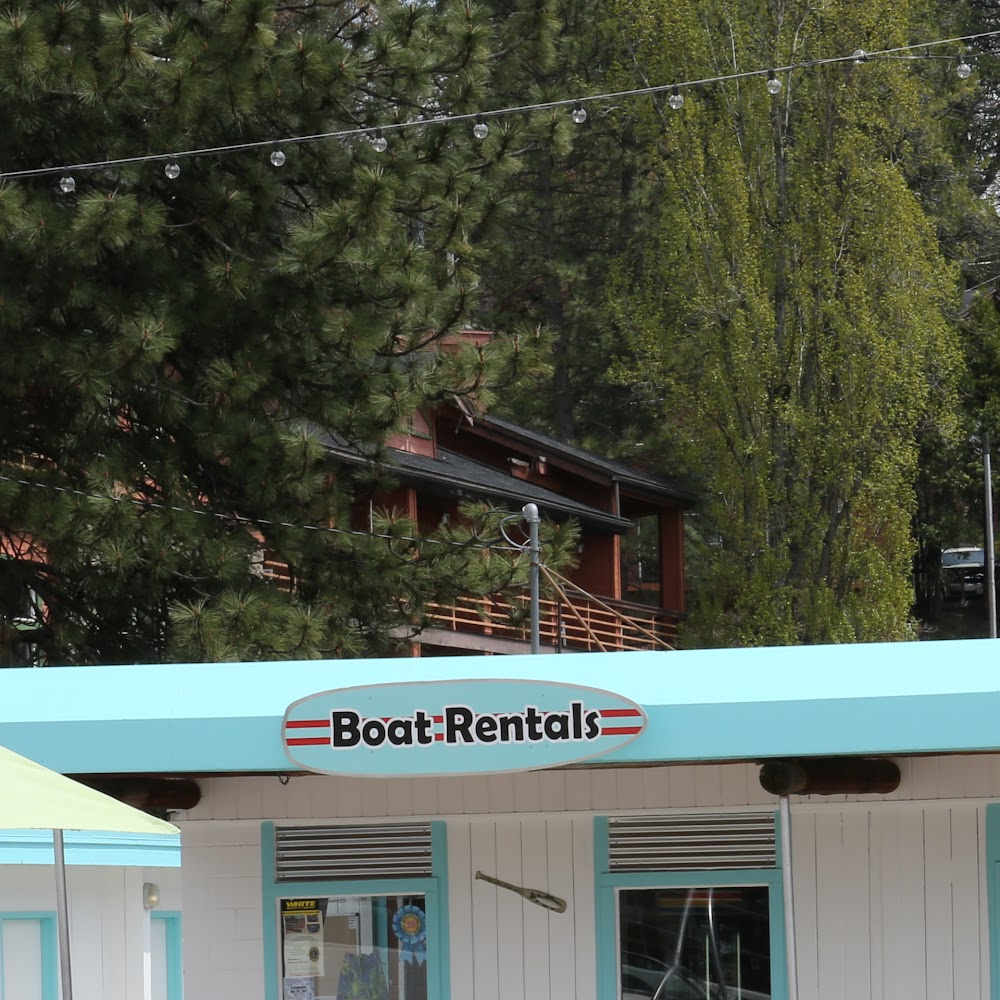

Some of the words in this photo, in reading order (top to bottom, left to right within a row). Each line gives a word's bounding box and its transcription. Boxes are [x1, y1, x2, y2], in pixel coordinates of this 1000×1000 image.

[332, 710, 433, 748] Boat
[445, 702, 601, 744] Rentals
[286, 900, 316, 908] WHITE
